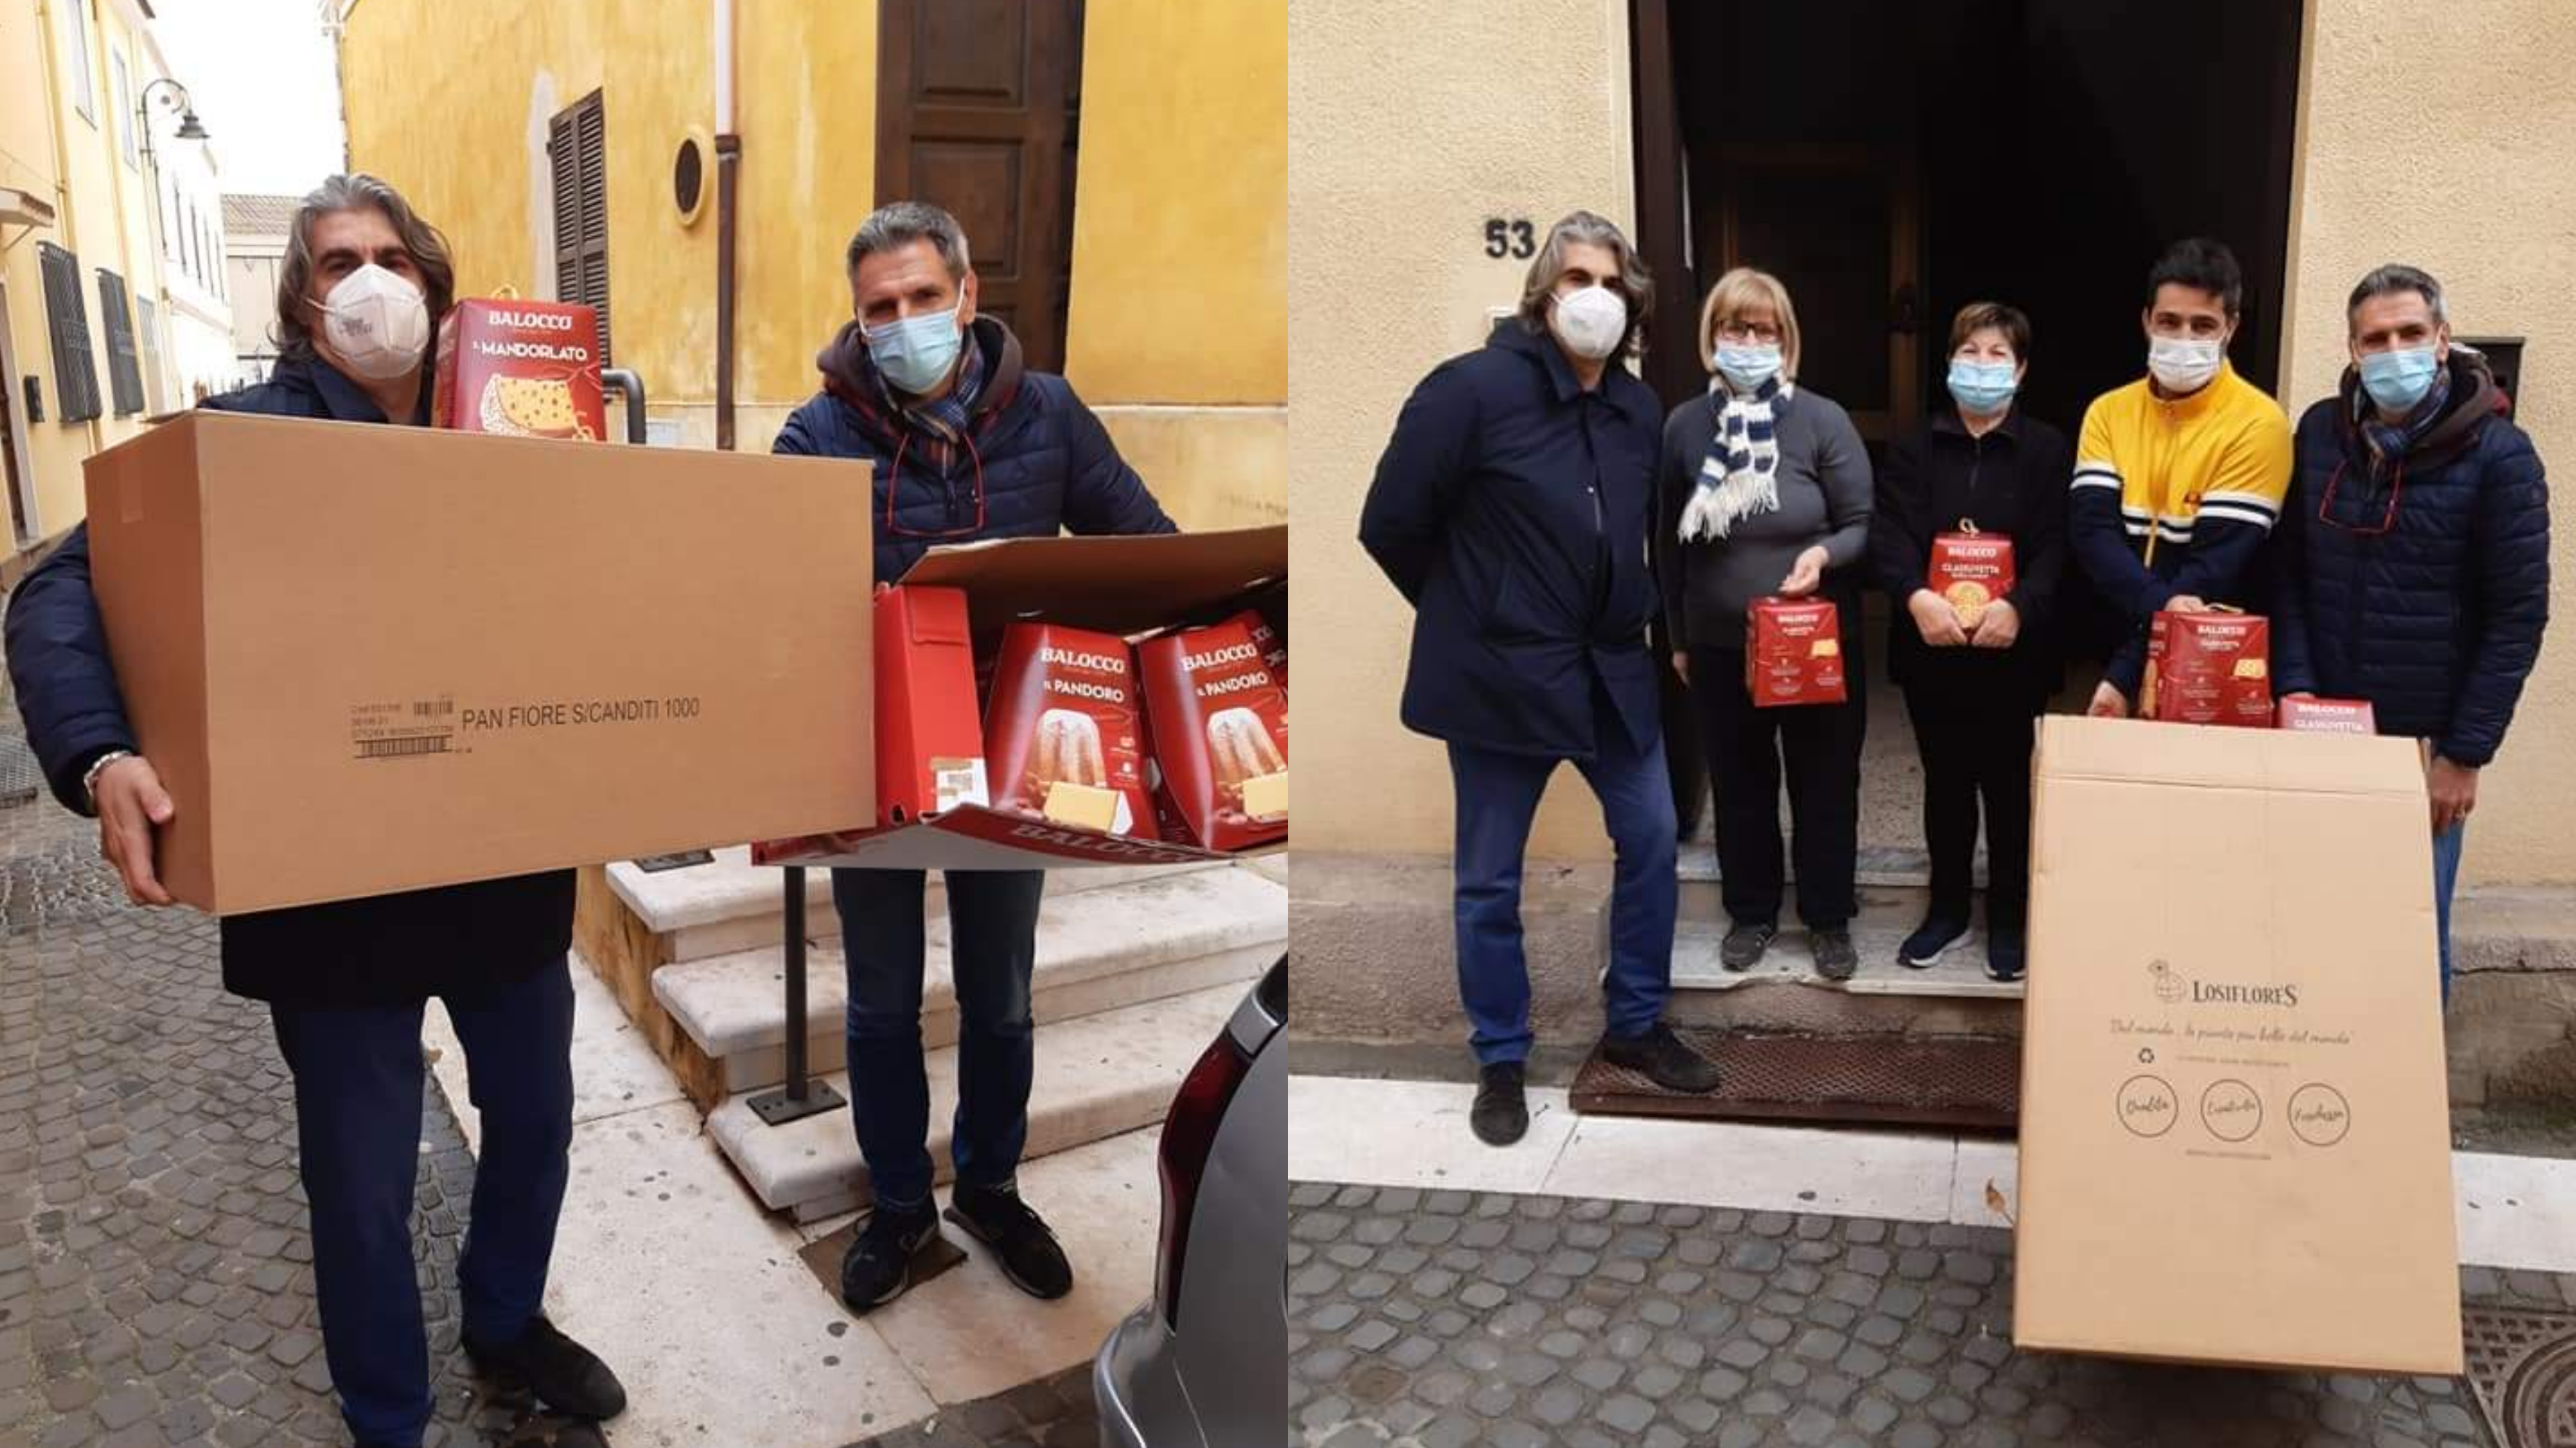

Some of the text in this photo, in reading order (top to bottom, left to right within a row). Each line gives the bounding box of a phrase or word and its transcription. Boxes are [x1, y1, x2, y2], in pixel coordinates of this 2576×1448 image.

[1486, 219, 1536, 259] 53
[489, 310, 572, 330] BALOCCO
[481, 340, 587, 361] MANDORLATO
[1041, 646, 1125, 673] BALOCCO
[1180, 643, 1258, 672] BALOCCO
[1054, 679, 1124, 702] PANDORO
[1205, 671, 1268, 695] PANDORO
[462, 697, 700, 730] PAN FIORE S/CANDITI 1000
